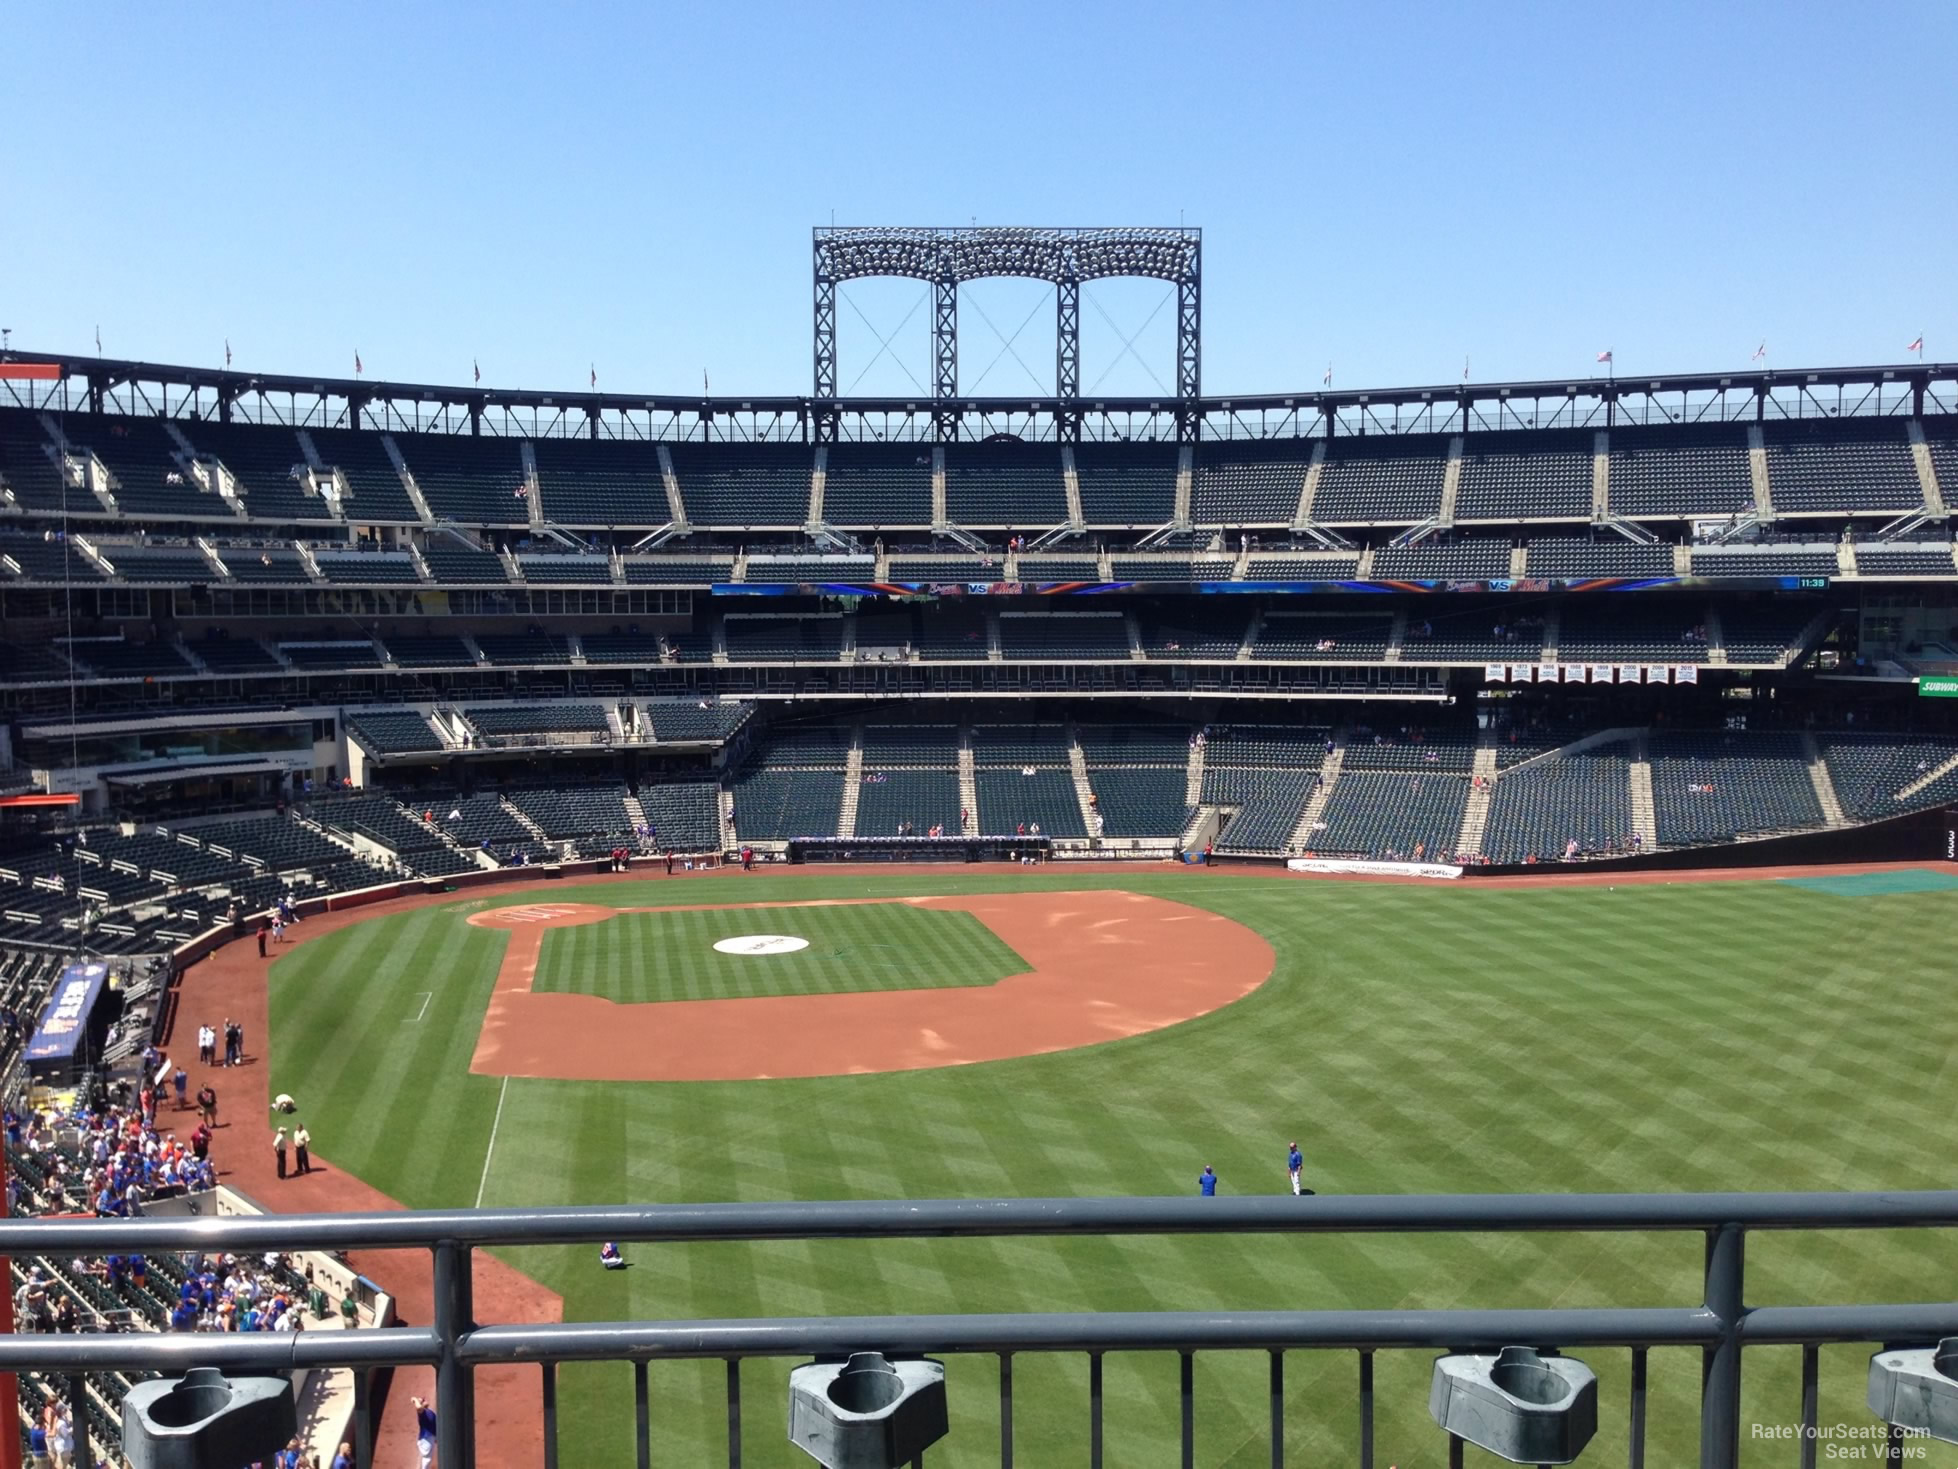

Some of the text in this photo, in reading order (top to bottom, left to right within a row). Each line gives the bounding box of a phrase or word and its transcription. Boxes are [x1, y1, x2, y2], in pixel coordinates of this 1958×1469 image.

[1489, 581, 1509, 591] VS
[1801, 579, 1825, 587] 11:39
[968, 584, 987, 593] VS
